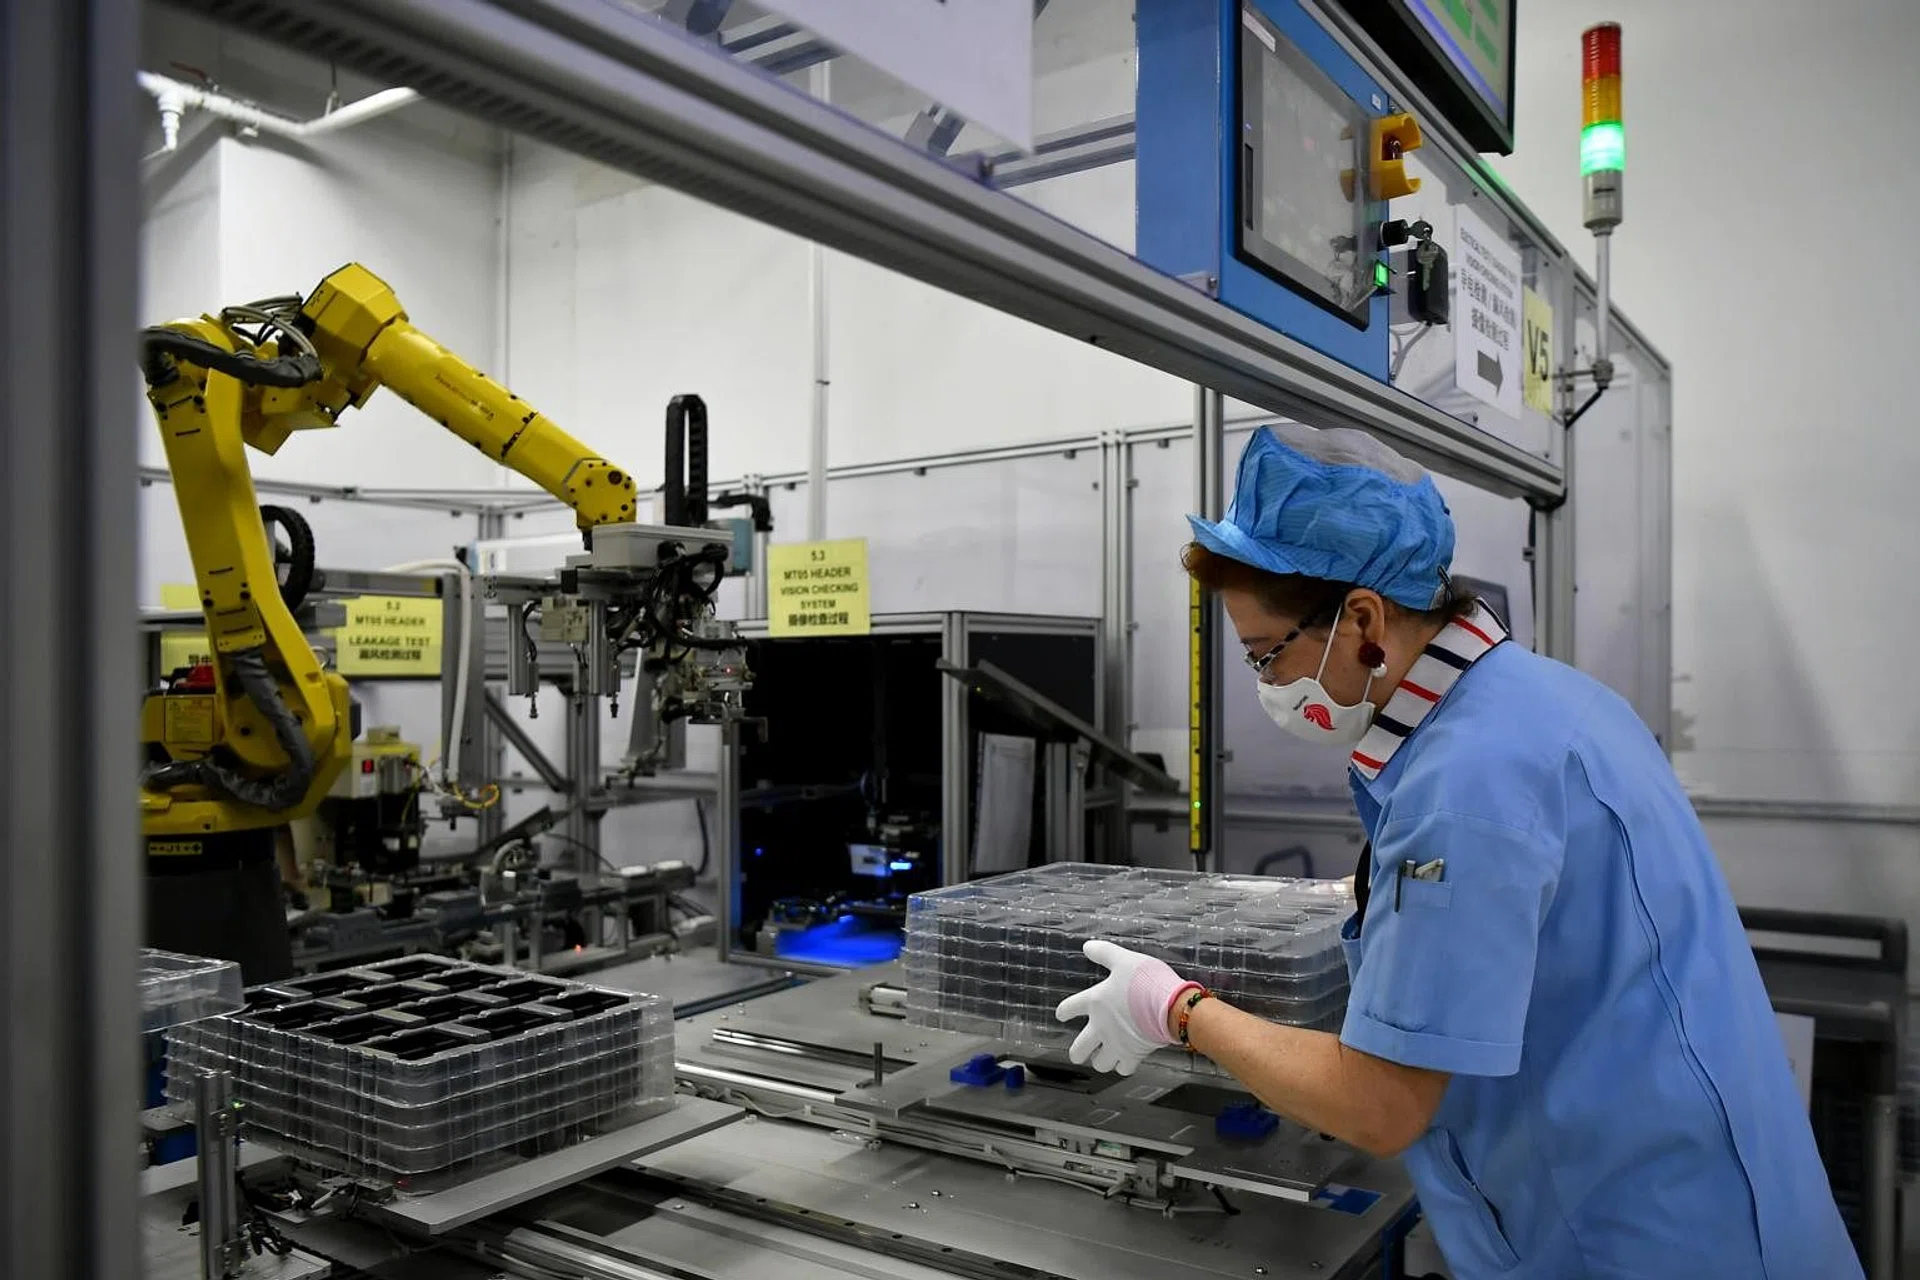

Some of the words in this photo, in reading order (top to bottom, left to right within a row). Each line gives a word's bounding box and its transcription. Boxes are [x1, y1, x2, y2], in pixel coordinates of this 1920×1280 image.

[1527, 319, 1549, 381] V5
[811, 550, 825, 561] 5.3
[811, 566, 851, 579] HEADER
[781, 585, 809, 595] VISION
[811, 582, 859, 595] CHECKING
[801, 599, 837, 610] SYSTEM
[384, 616, 426, 627] HEADER
[348, 635, 401, 647] LEAKAGE
[405, 636, 430, 648] TEST
